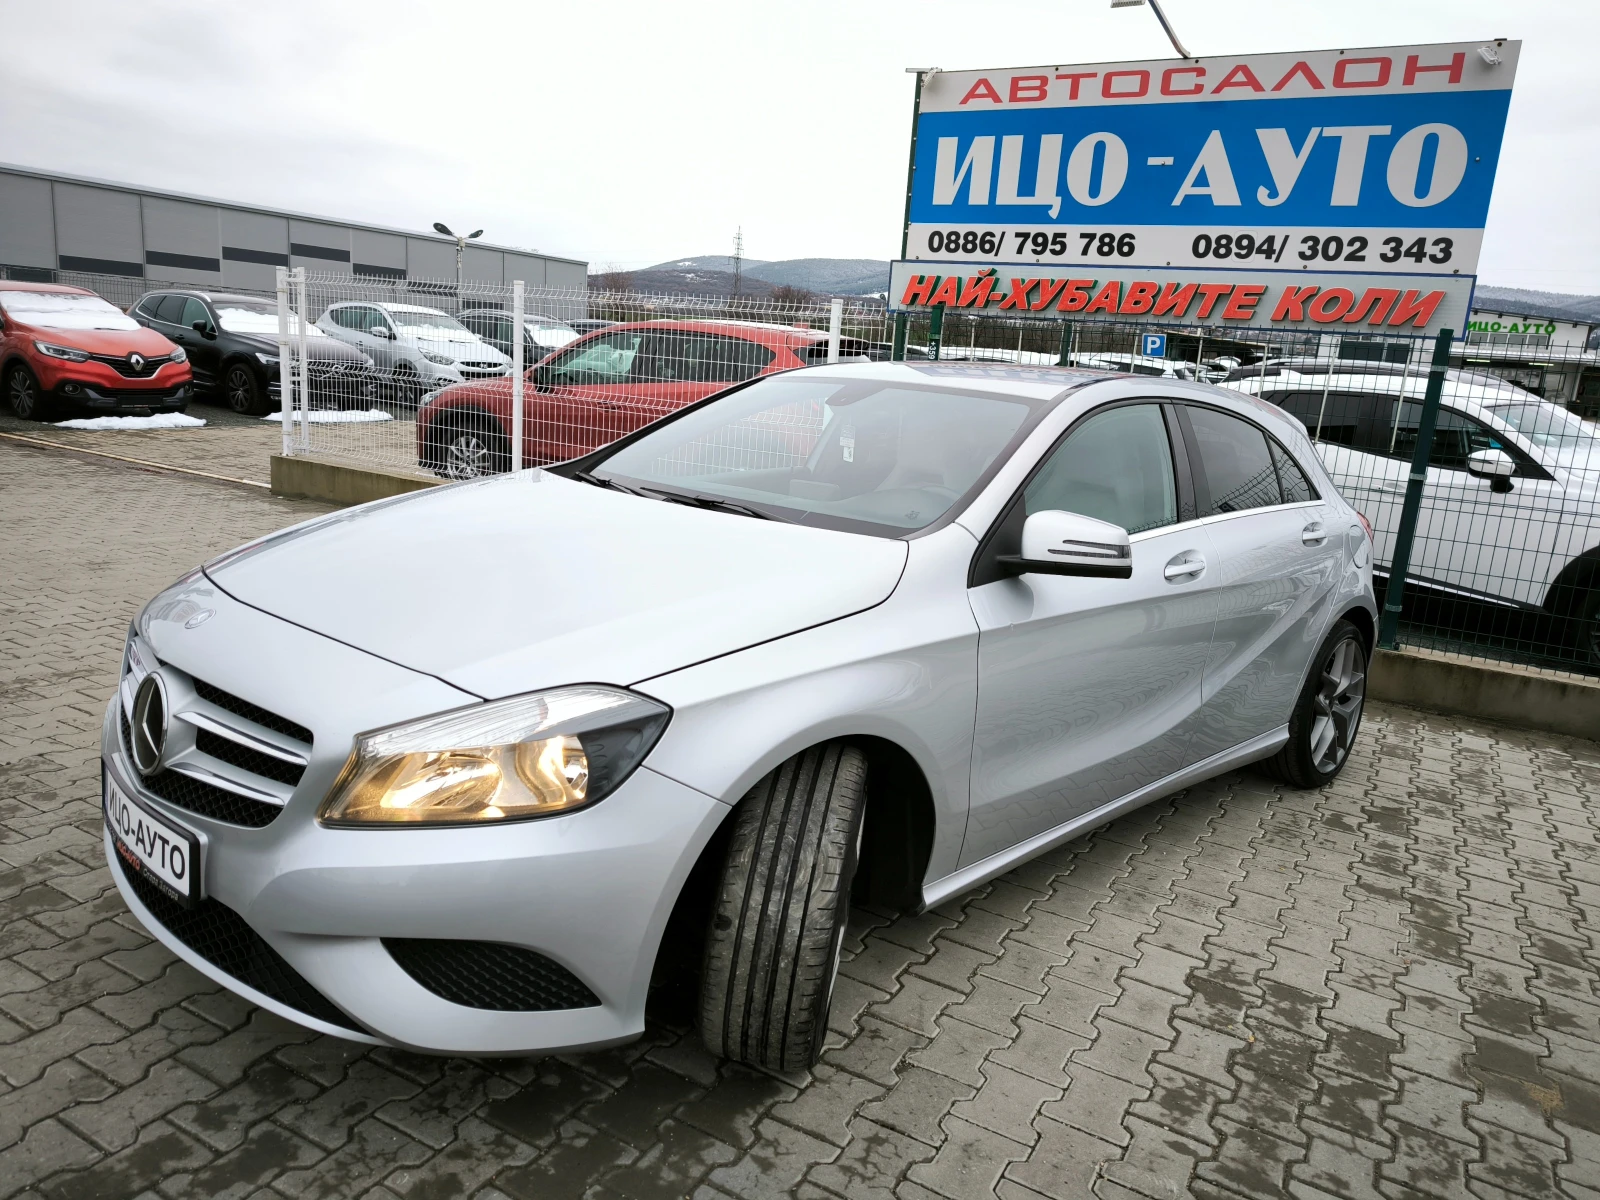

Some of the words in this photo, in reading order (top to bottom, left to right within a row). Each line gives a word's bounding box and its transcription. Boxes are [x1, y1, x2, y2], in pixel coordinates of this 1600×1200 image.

[959, 52, 1466, 105] АВТОСАЛОН
[928, 230, 1005, 257] 0886/
[1014, 232, 1067, 256] 795
[1079, 233, 1136, 257] 786
[1192, 234, 1289, 263] 0894/
[1298, 235, 1368, 262] 302
[1379, 236, 1453, 264] 343
[901, 268, 1267, 320] НАЙ-ХУБАВИТЕ
[1270, 285, 1446, 328] КОЛИ
[1467, 321, 1556, 334] ИЦО-АУТО
[1146, 336, 1161, 354] P
[109, 781, 186, 880] ИЦО-АУТО
